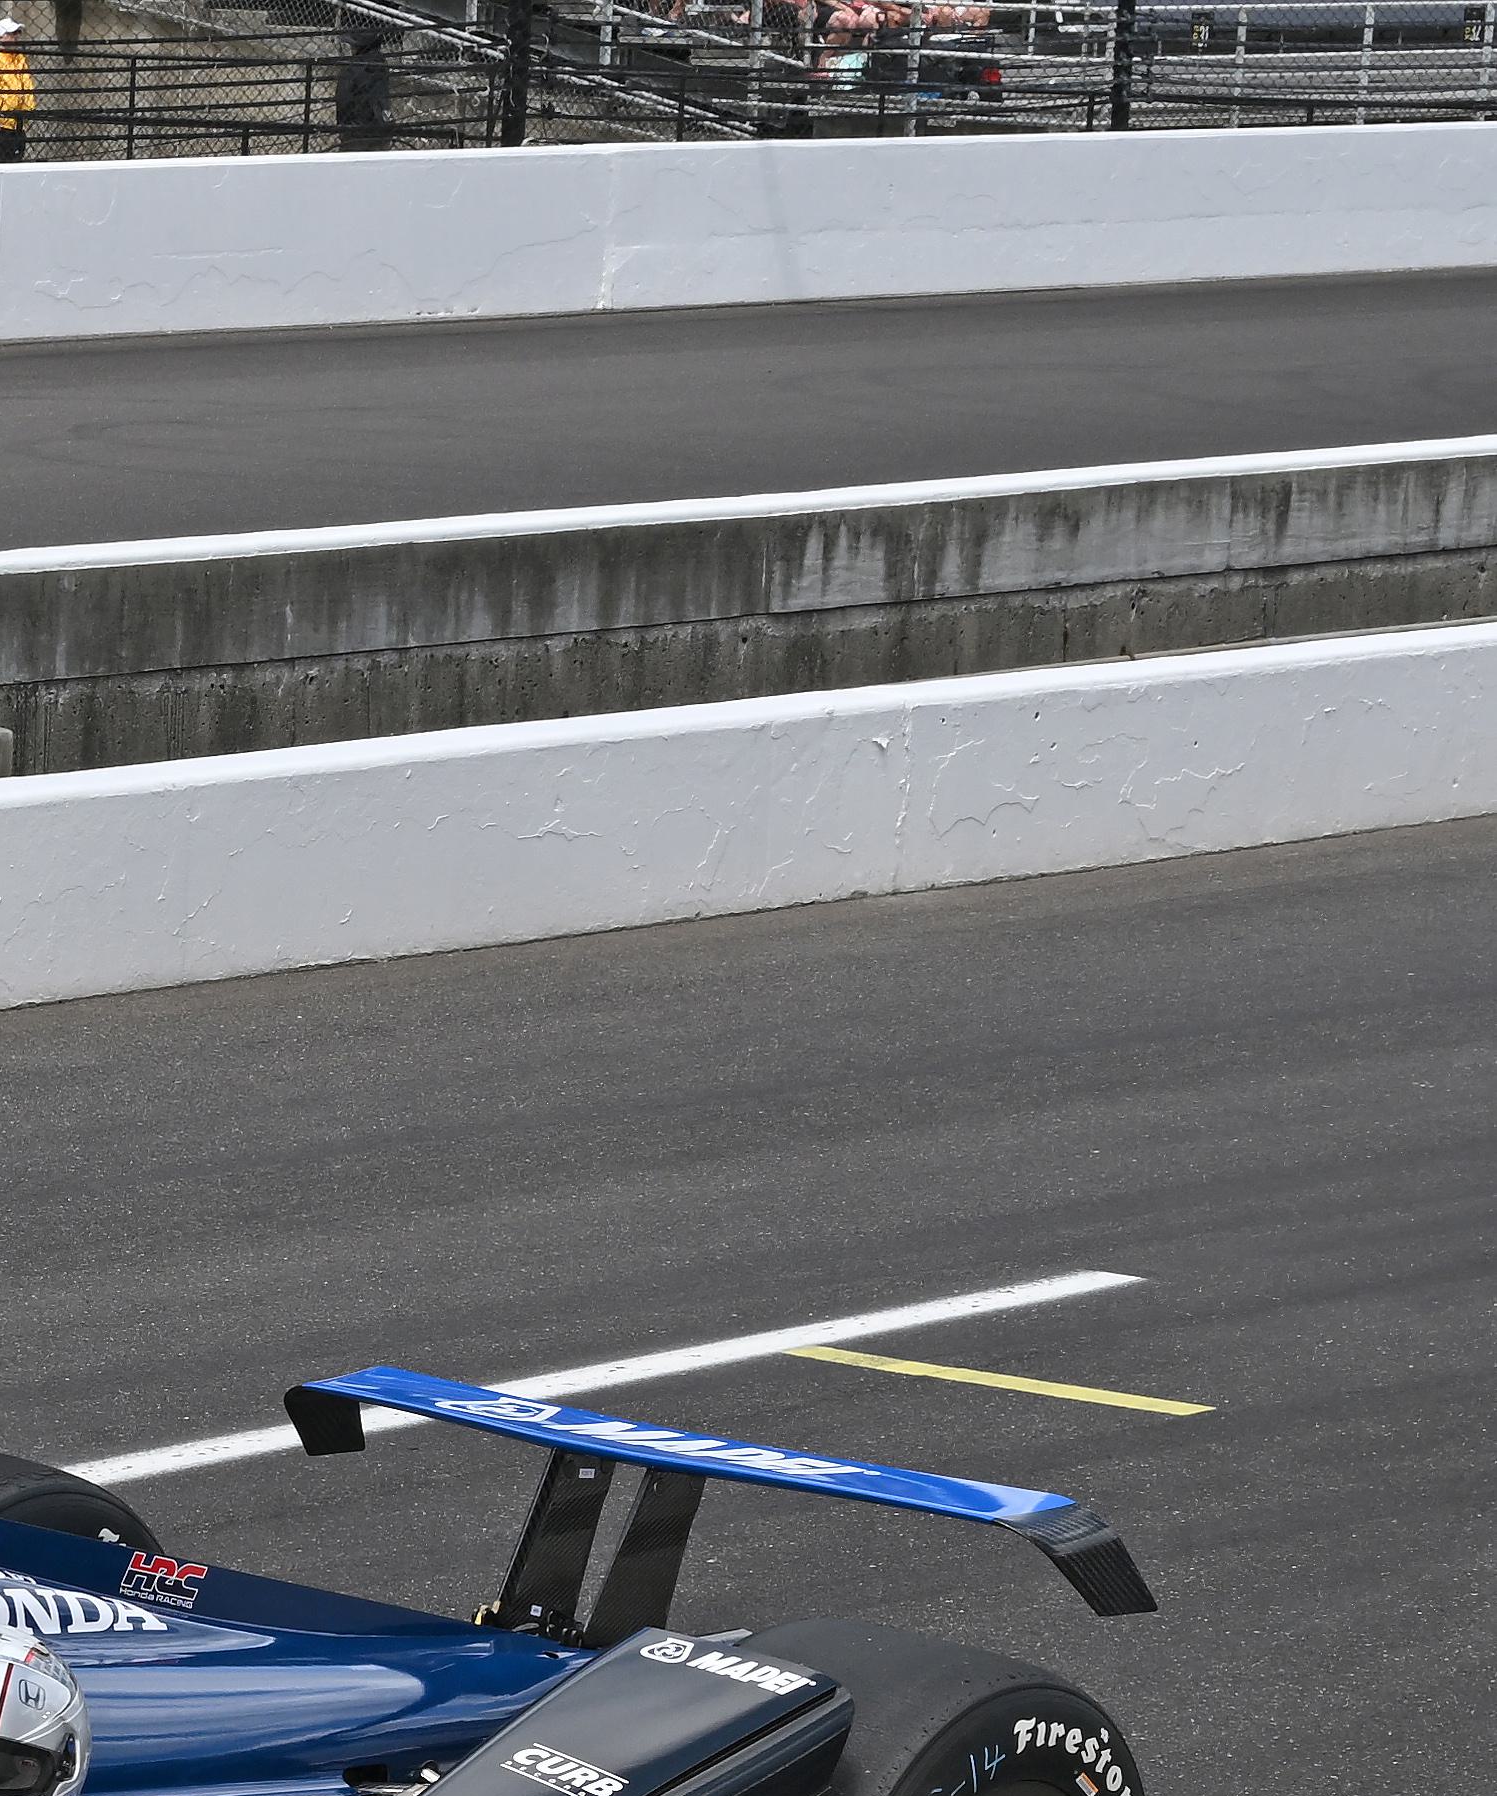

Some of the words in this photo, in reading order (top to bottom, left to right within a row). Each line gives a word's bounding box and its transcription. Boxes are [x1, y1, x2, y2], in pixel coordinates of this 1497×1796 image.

[549, 1420, 868, 1475] MAPEI
[121, 1551, 208, 1600] HRC
[685, 1650, 810, 1696] MAPEI
